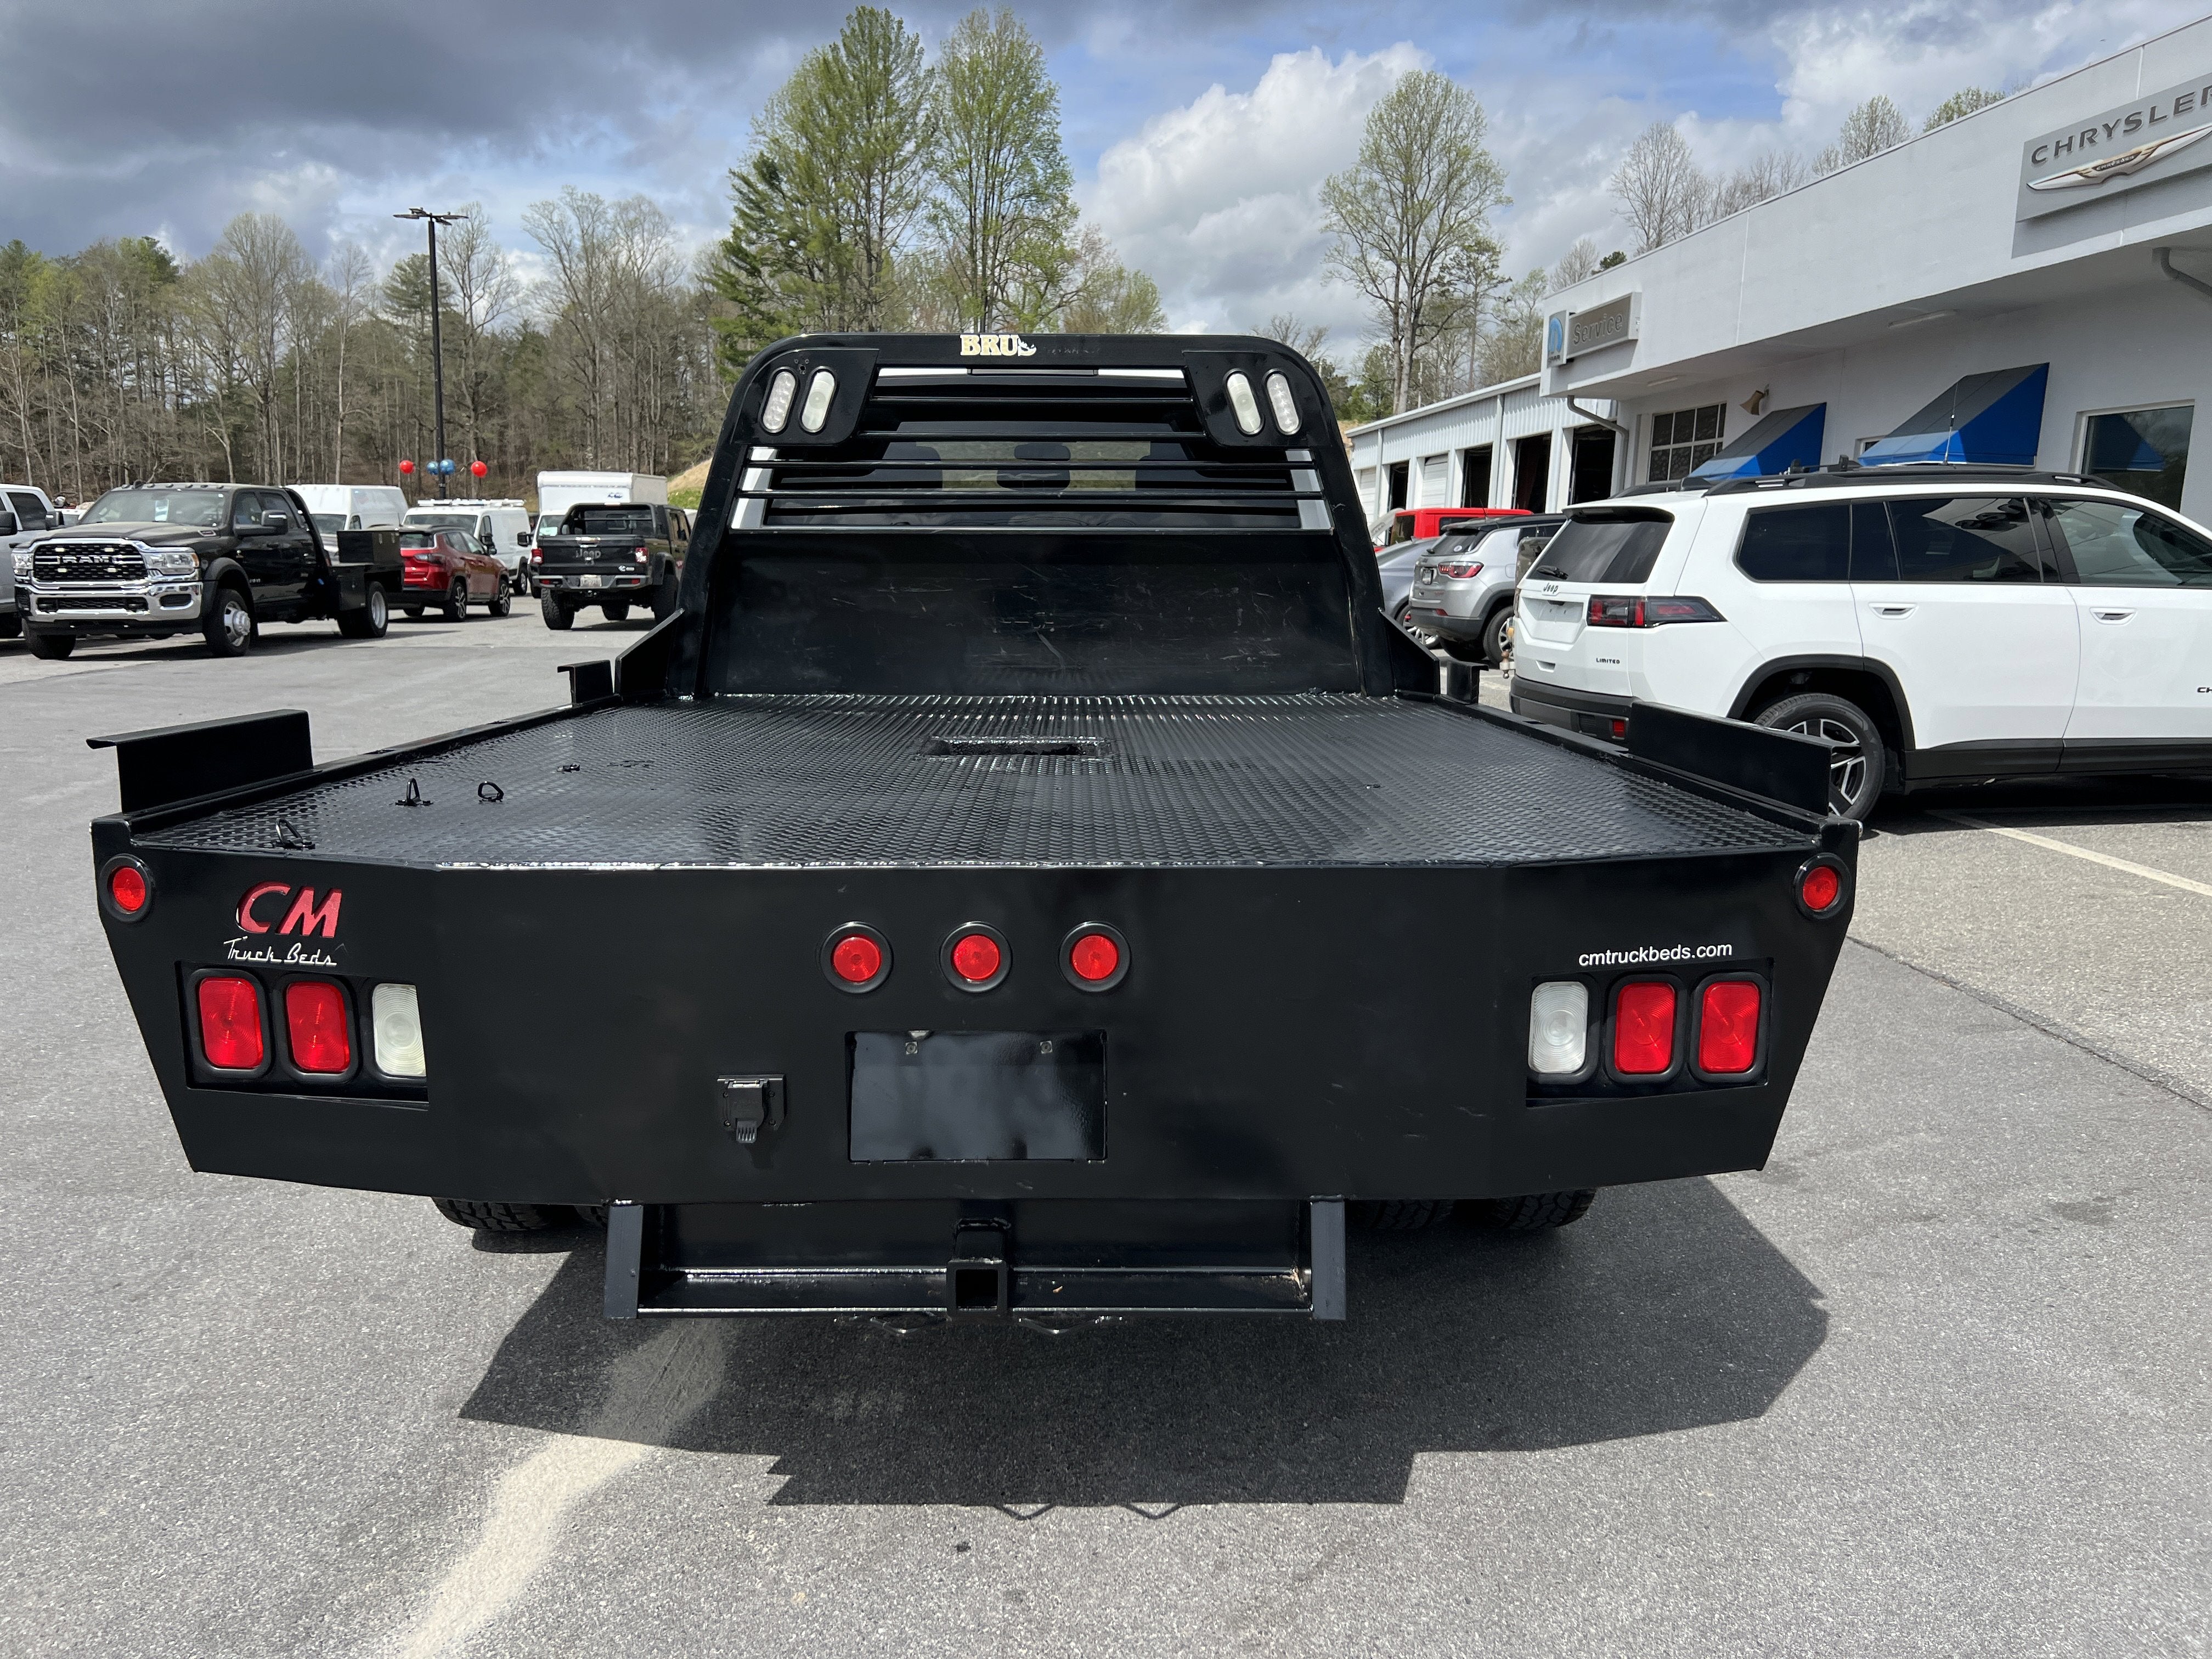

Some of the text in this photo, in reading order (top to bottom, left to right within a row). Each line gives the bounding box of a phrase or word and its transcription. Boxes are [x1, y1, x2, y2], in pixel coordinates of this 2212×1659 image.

[1572, 313, 1623, 345] Service
[62, 555, 110, 563] RAM
[1543, 583, 1559, 594] Jeep
[235, 881, 342, 939] CM
[223, 935, 337, 966] Truck Beds
[1578, 944, 1733, 967] cmtruckbeds.com
